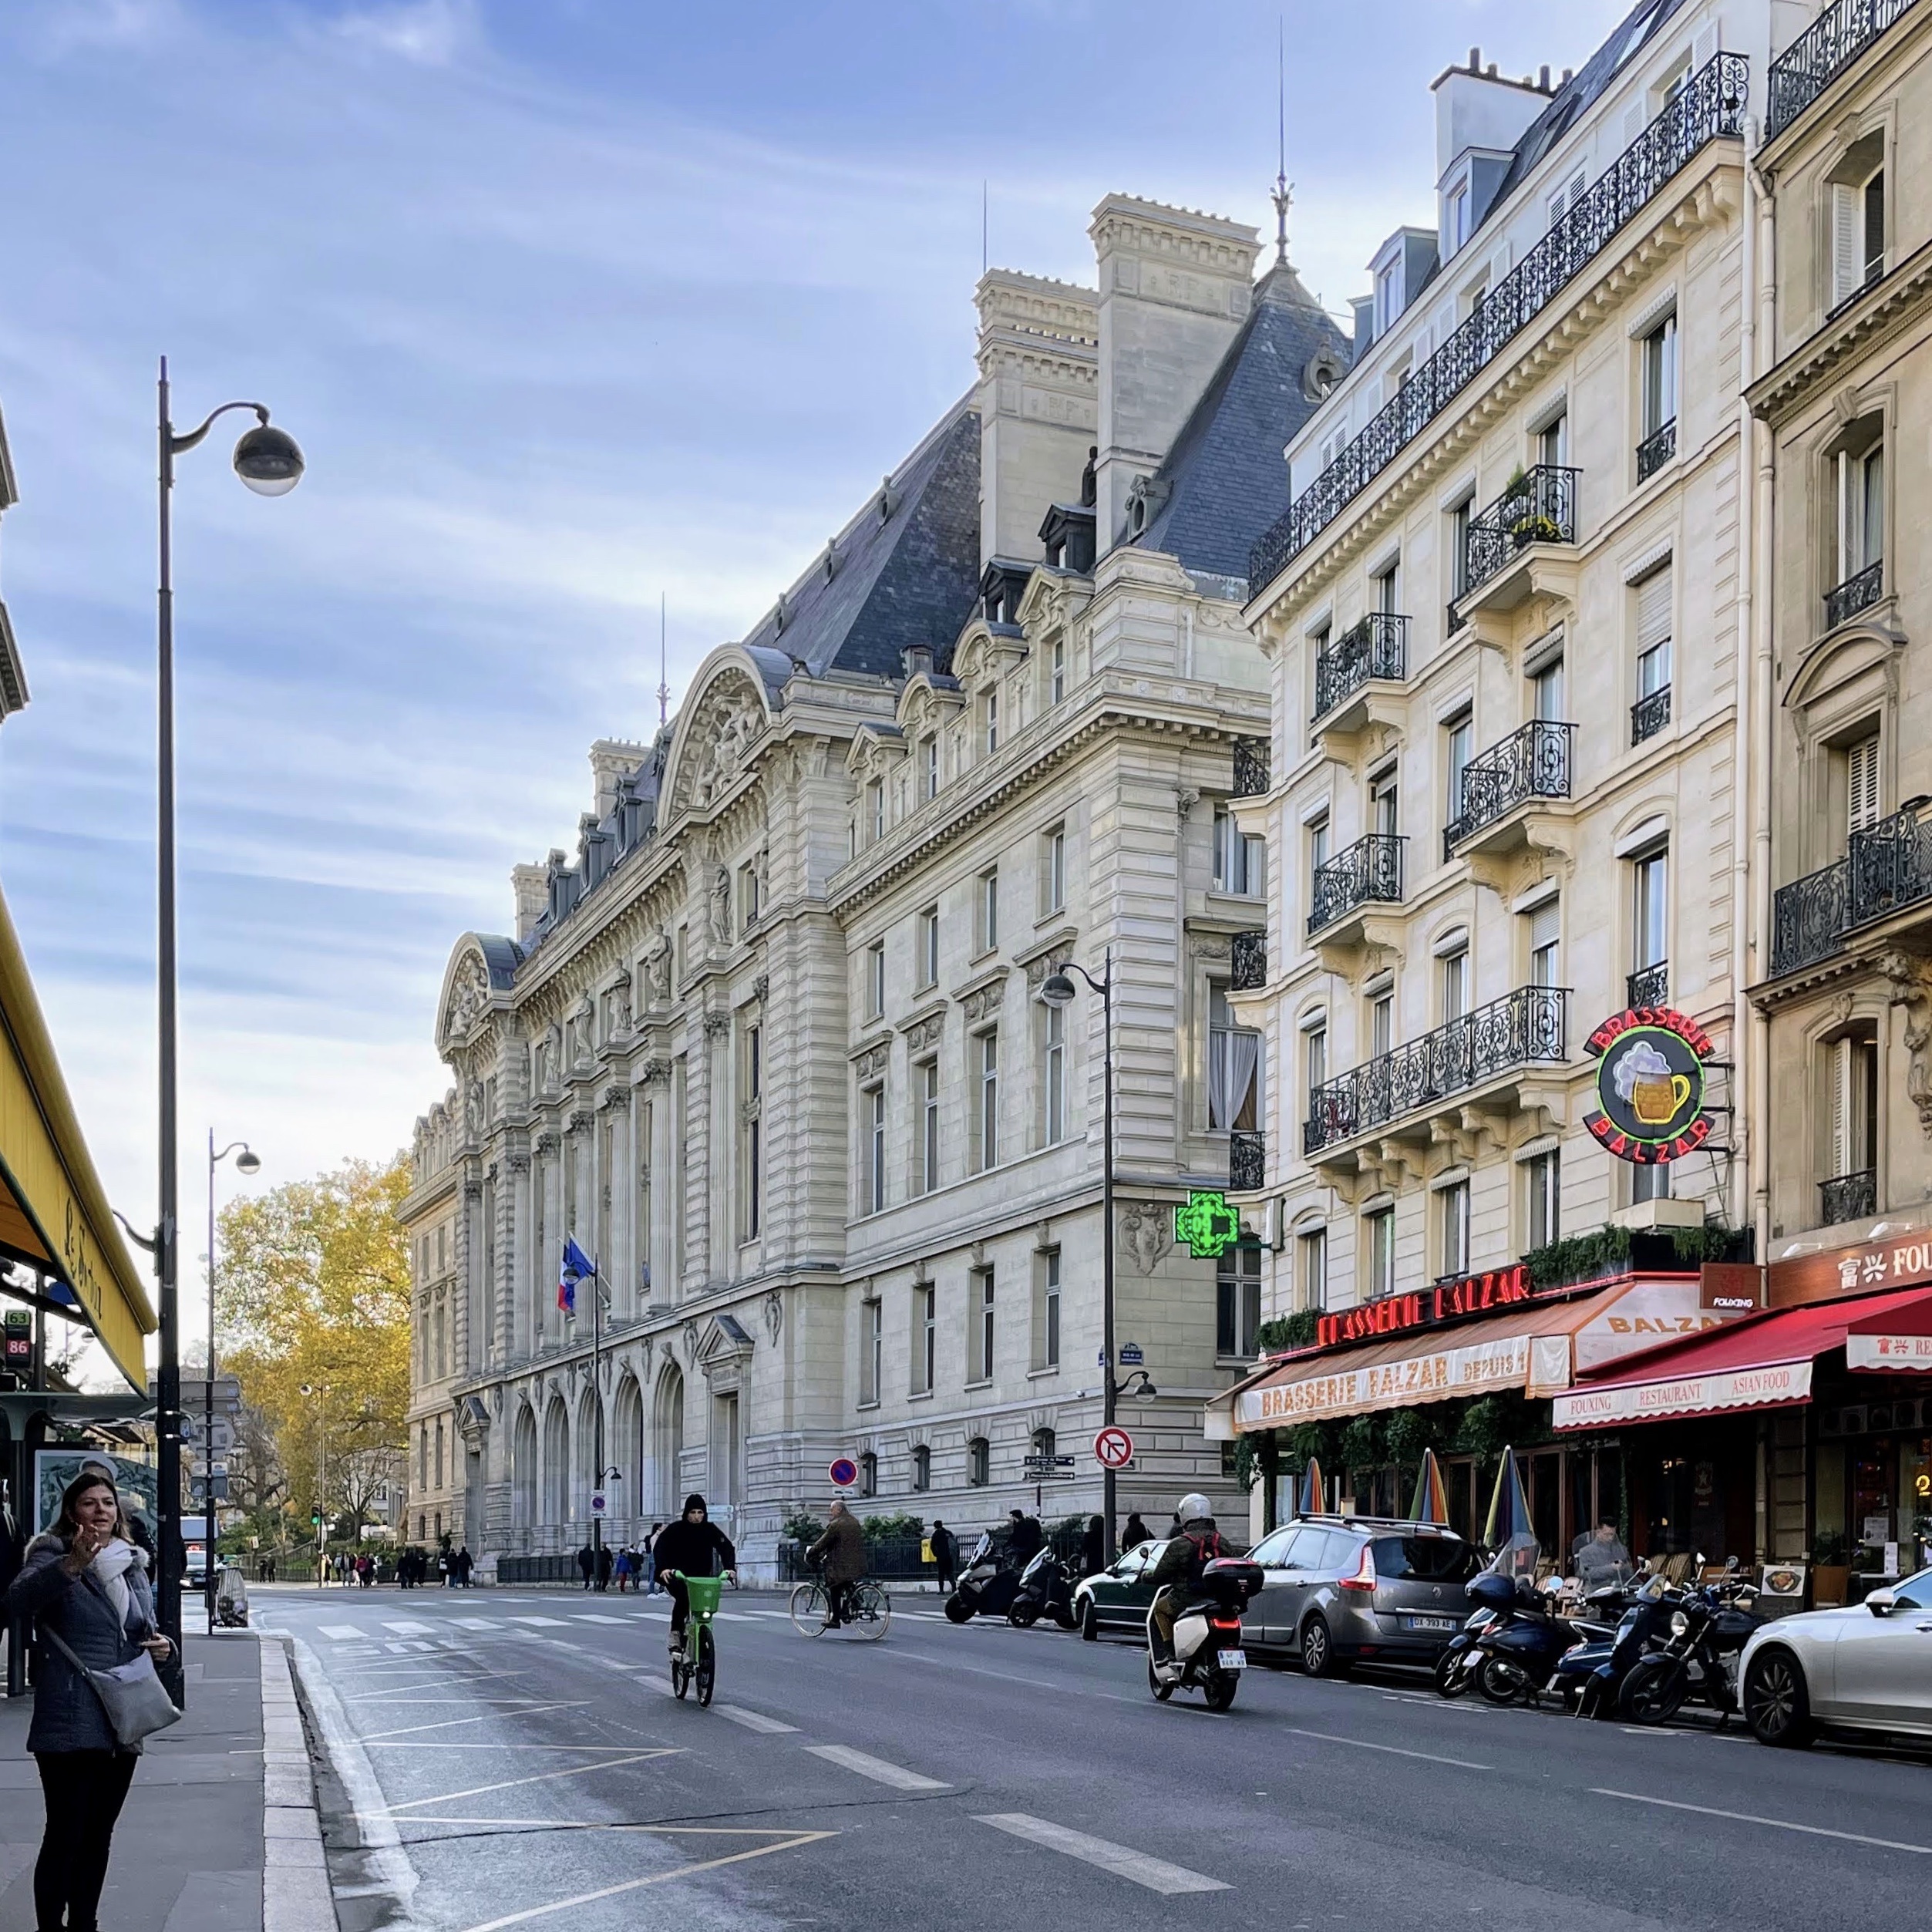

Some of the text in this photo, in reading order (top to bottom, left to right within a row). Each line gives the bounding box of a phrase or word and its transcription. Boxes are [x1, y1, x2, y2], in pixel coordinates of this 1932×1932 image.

[1591, 1006, 1714, 1054] BRASSERIE
[1591, 1117, 1708, 1163] BALZAR
[1837, 1252, 1888, 1290] 富兴
[10, 1313, 26, 1324] 63
[1713, 1297, 1754, 1308] FOUXING
[9, 1341, 28, 1354] 86
[1915, 1339, 1932, 1355] RE
[1262, 1375, 1357, 1417] BRASSERIE
[1464, 1354, 1514, 1382] DEPUIS
[1570, 1372, 1790, 1415] FOUXING RESTAURANT ASIAN FOOD
